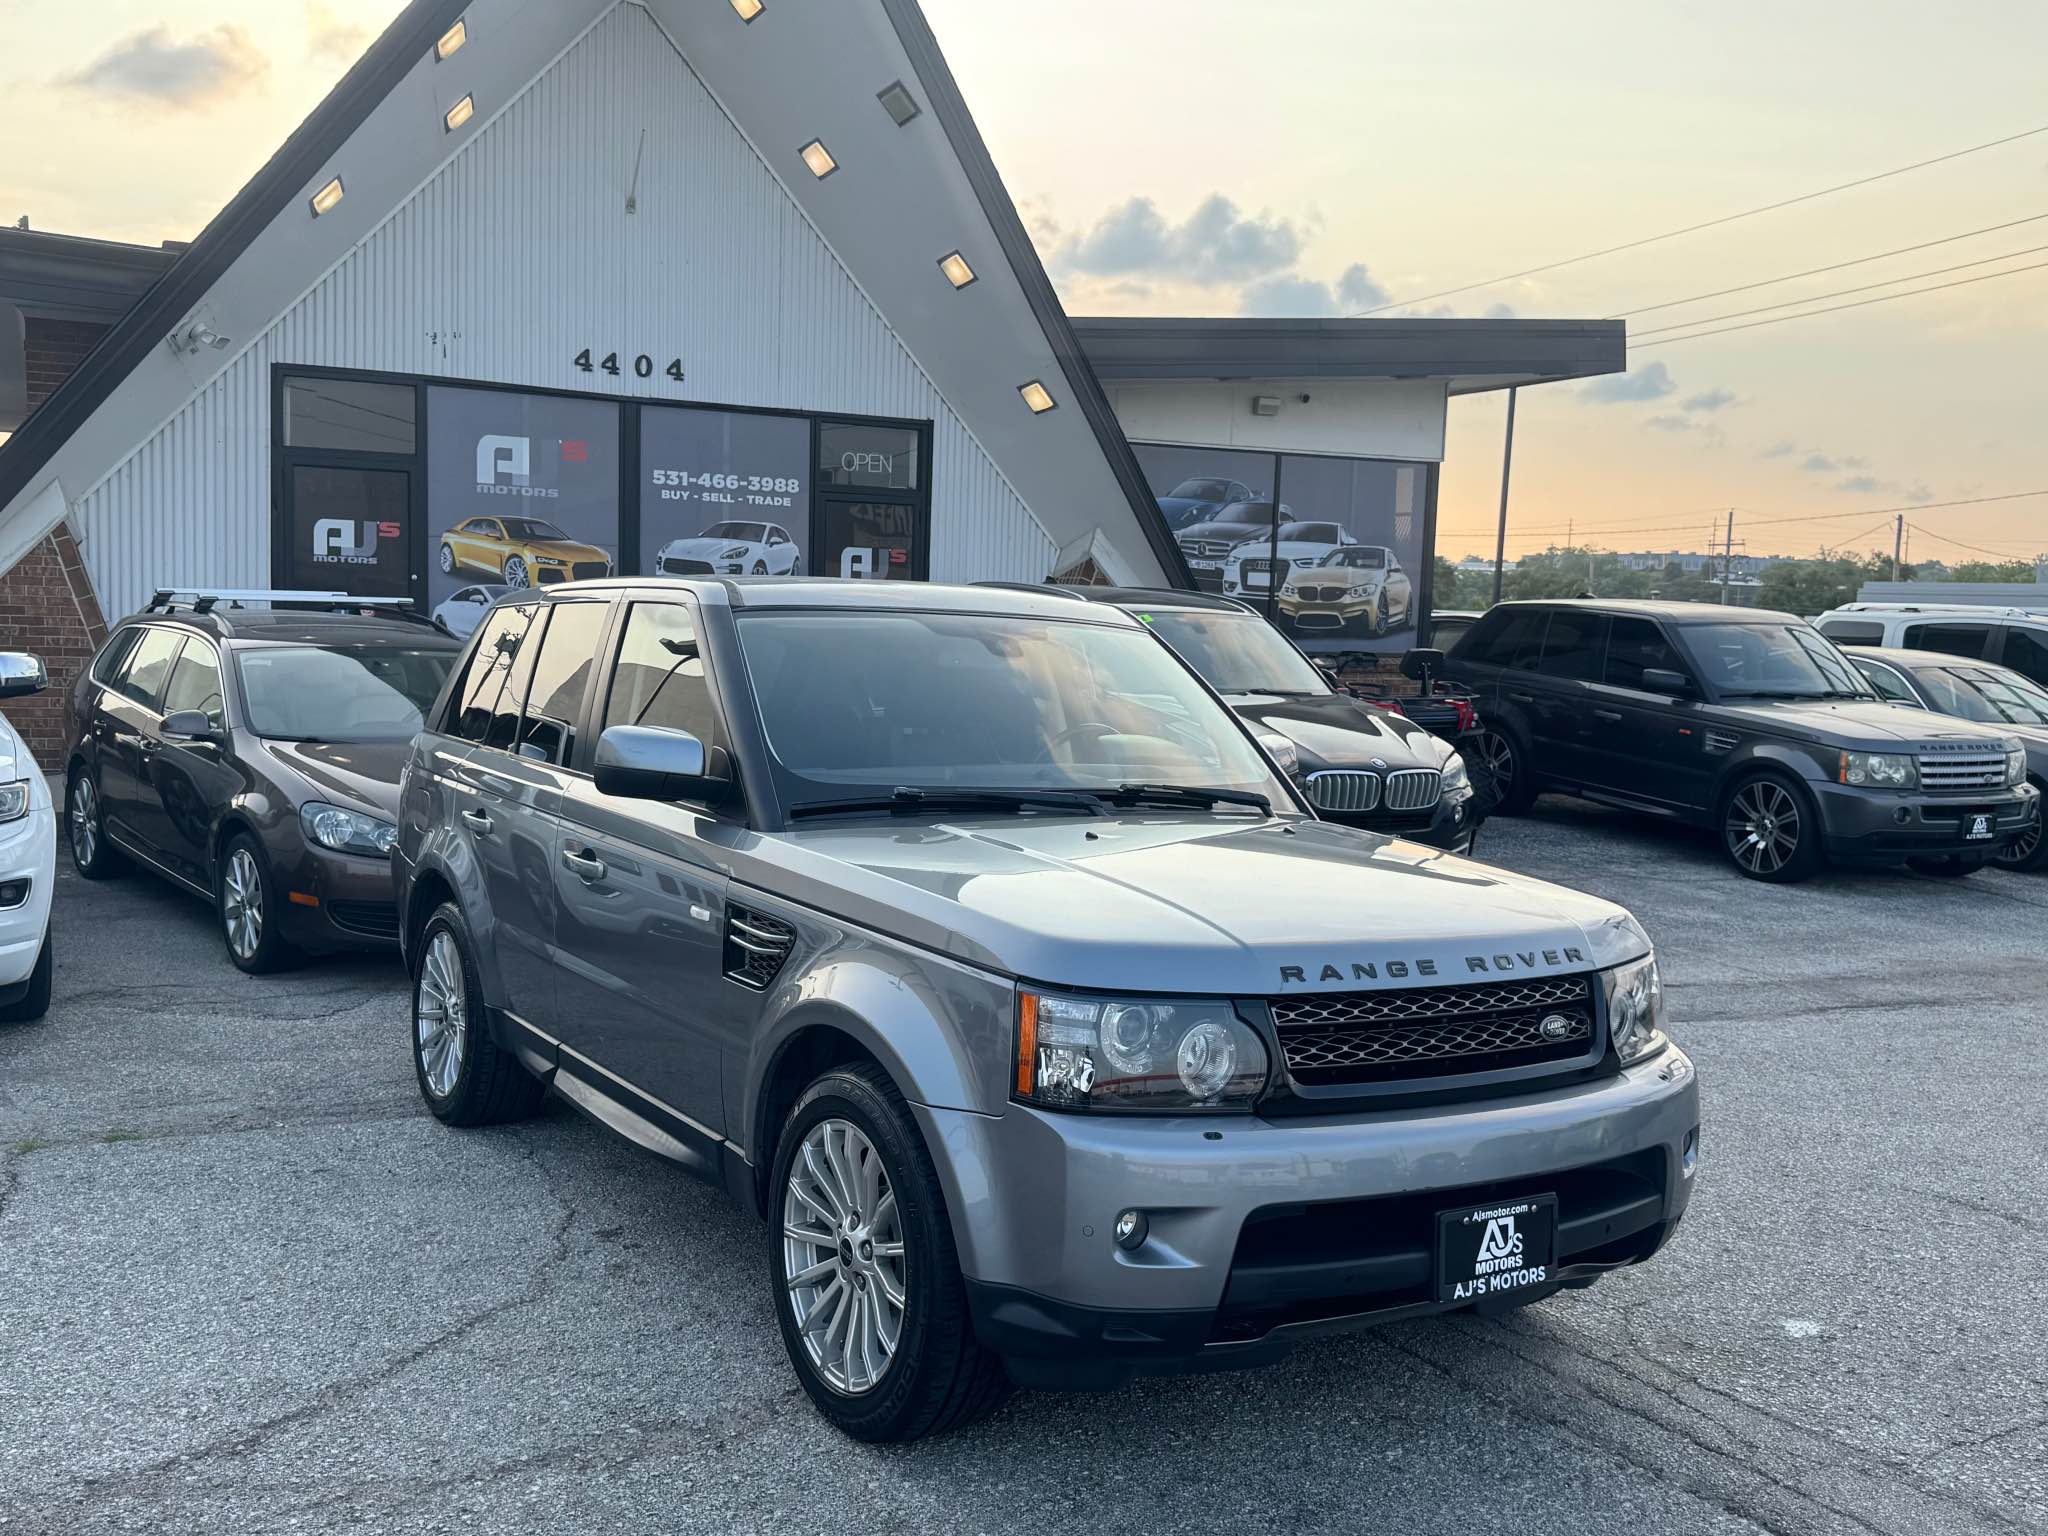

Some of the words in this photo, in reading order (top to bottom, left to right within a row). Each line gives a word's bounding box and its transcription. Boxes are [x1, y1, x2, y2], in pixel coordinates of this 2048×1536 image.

[574, 348, 685, 381] 4404
[841, 451, 893, 473] OPEN
[652, 469, 800, 493] 531-466-3988
[661, 489, 690, 501] BUY
[702, 492, 735, 503] SELL
[746, 495, 792, 506] TRADE
[1279, 959, 1439, 984] RANGE
[1465, 946, 1584, 972] ROVER
[1475, 1254, 1523, 1275] MOTORS
[1453, 1278, 1486, 1300] AJ'S
[1490, 1265, 1546, 1292] MOTORS
